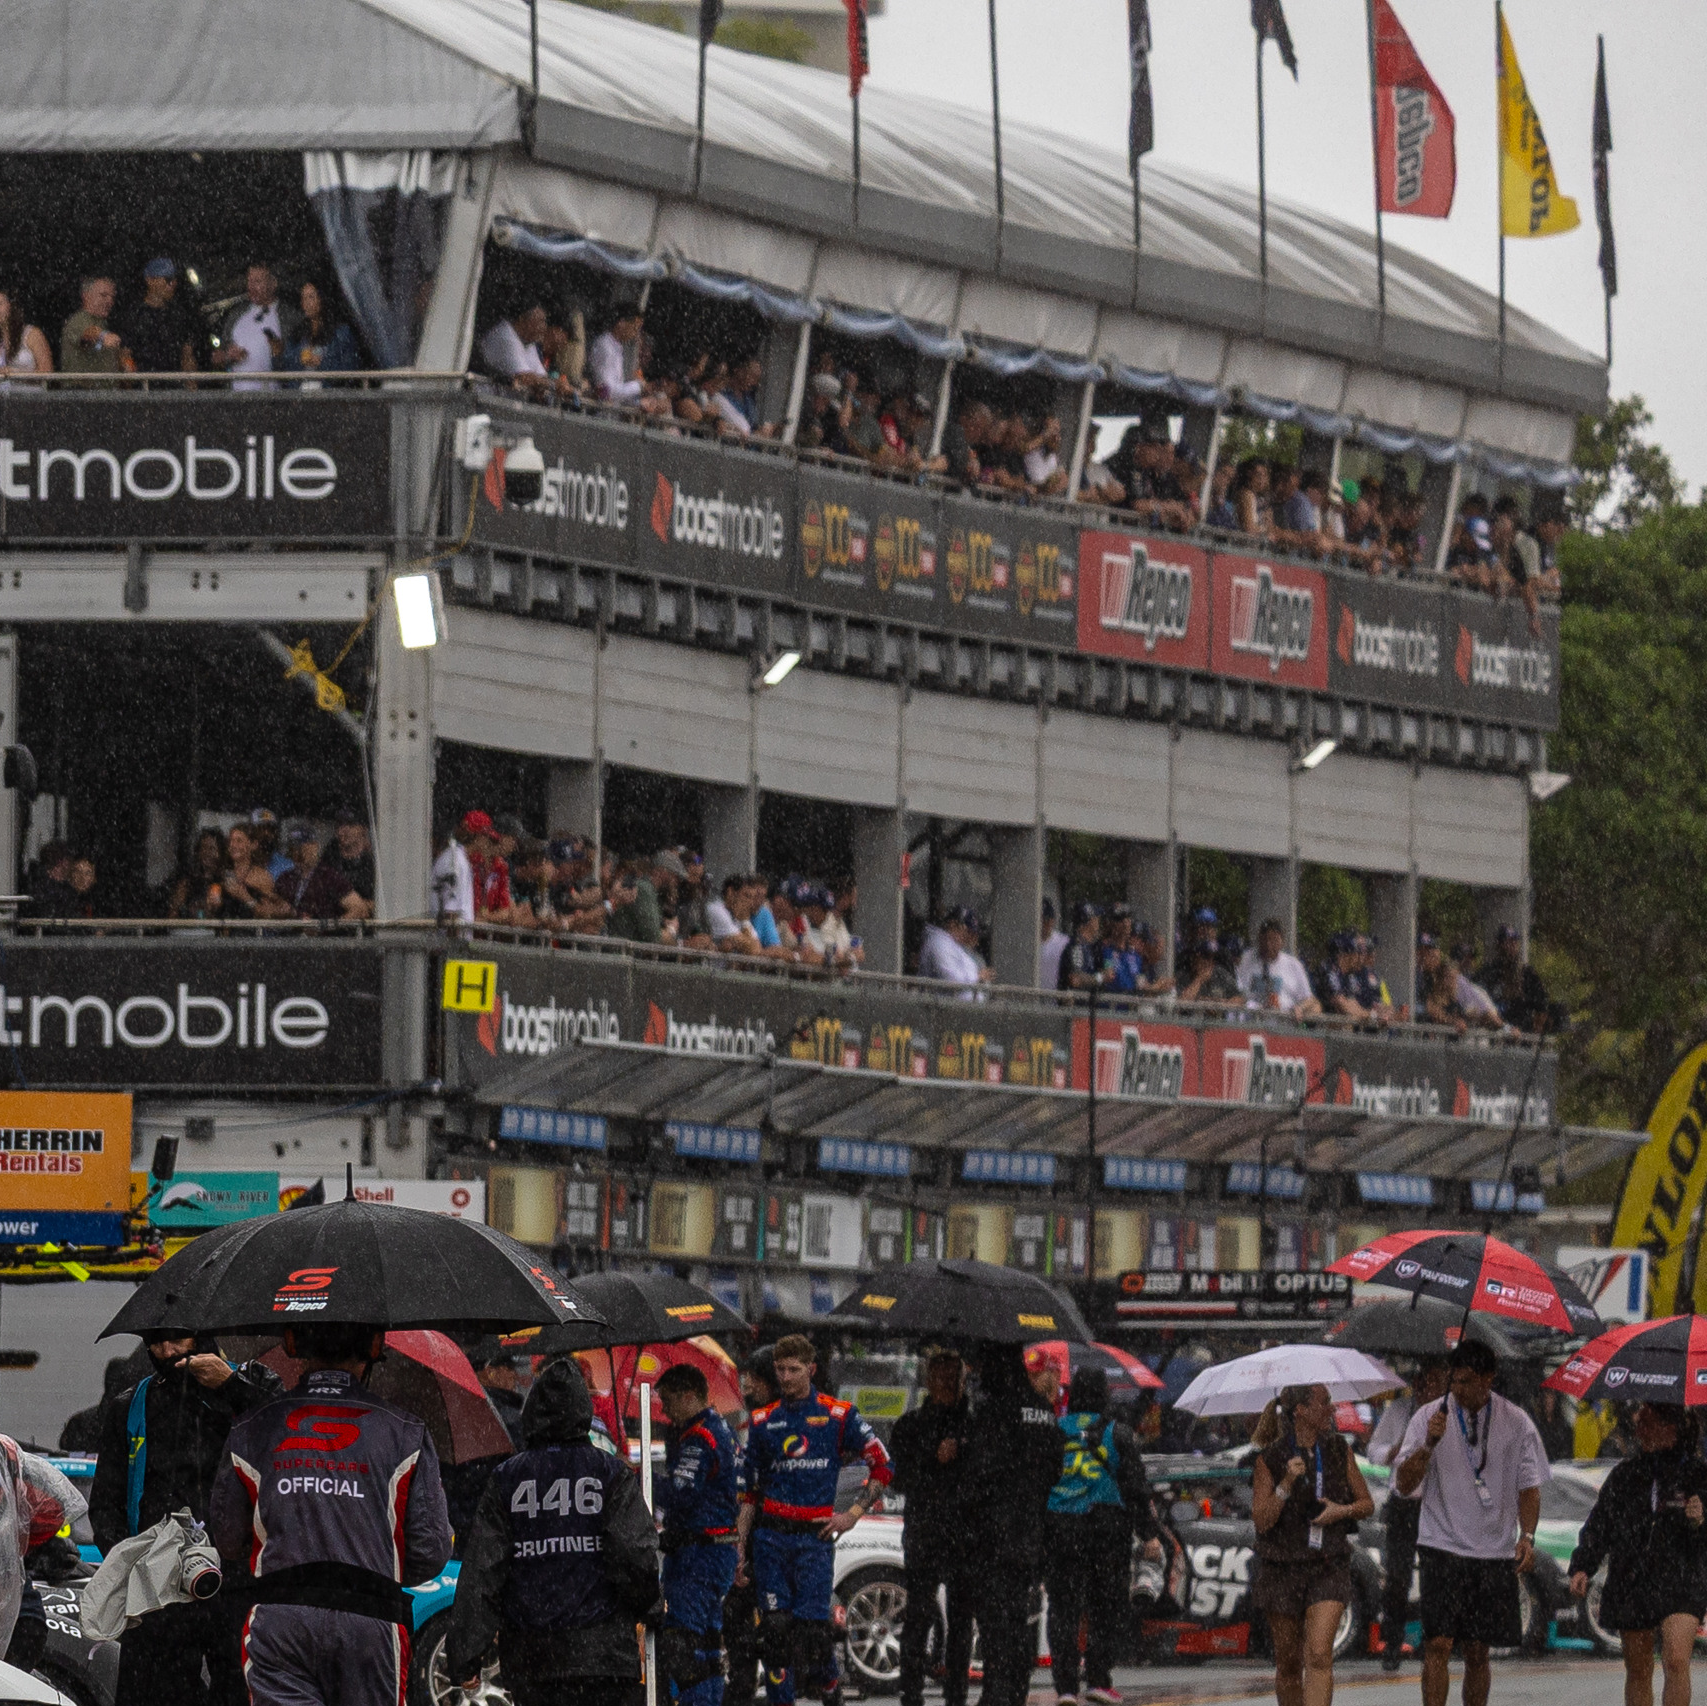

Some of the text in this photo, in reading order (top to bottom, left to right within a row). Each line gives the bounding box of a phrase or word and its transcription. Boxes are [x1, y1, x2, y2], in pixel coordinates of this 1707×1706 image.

[455, 967, 489, 1005] H
[196, 1190, 269, 1203] SNOWY RIVER
[354, 1188, 394, 1201] Shell
[1191, 1274, 1242, 1292] Mobil
[1275, 1273, 1347, 1293] OPTUS
[285, 1301, 327, 1313] Repco
[1021, 1408, 1049, 1423] TEAM
[274, 1458, 369, 1473] SUPERCARS
[277, 1477, 365, 1498] OFFICIAL
[511, 1477, 604, 1519] 446
